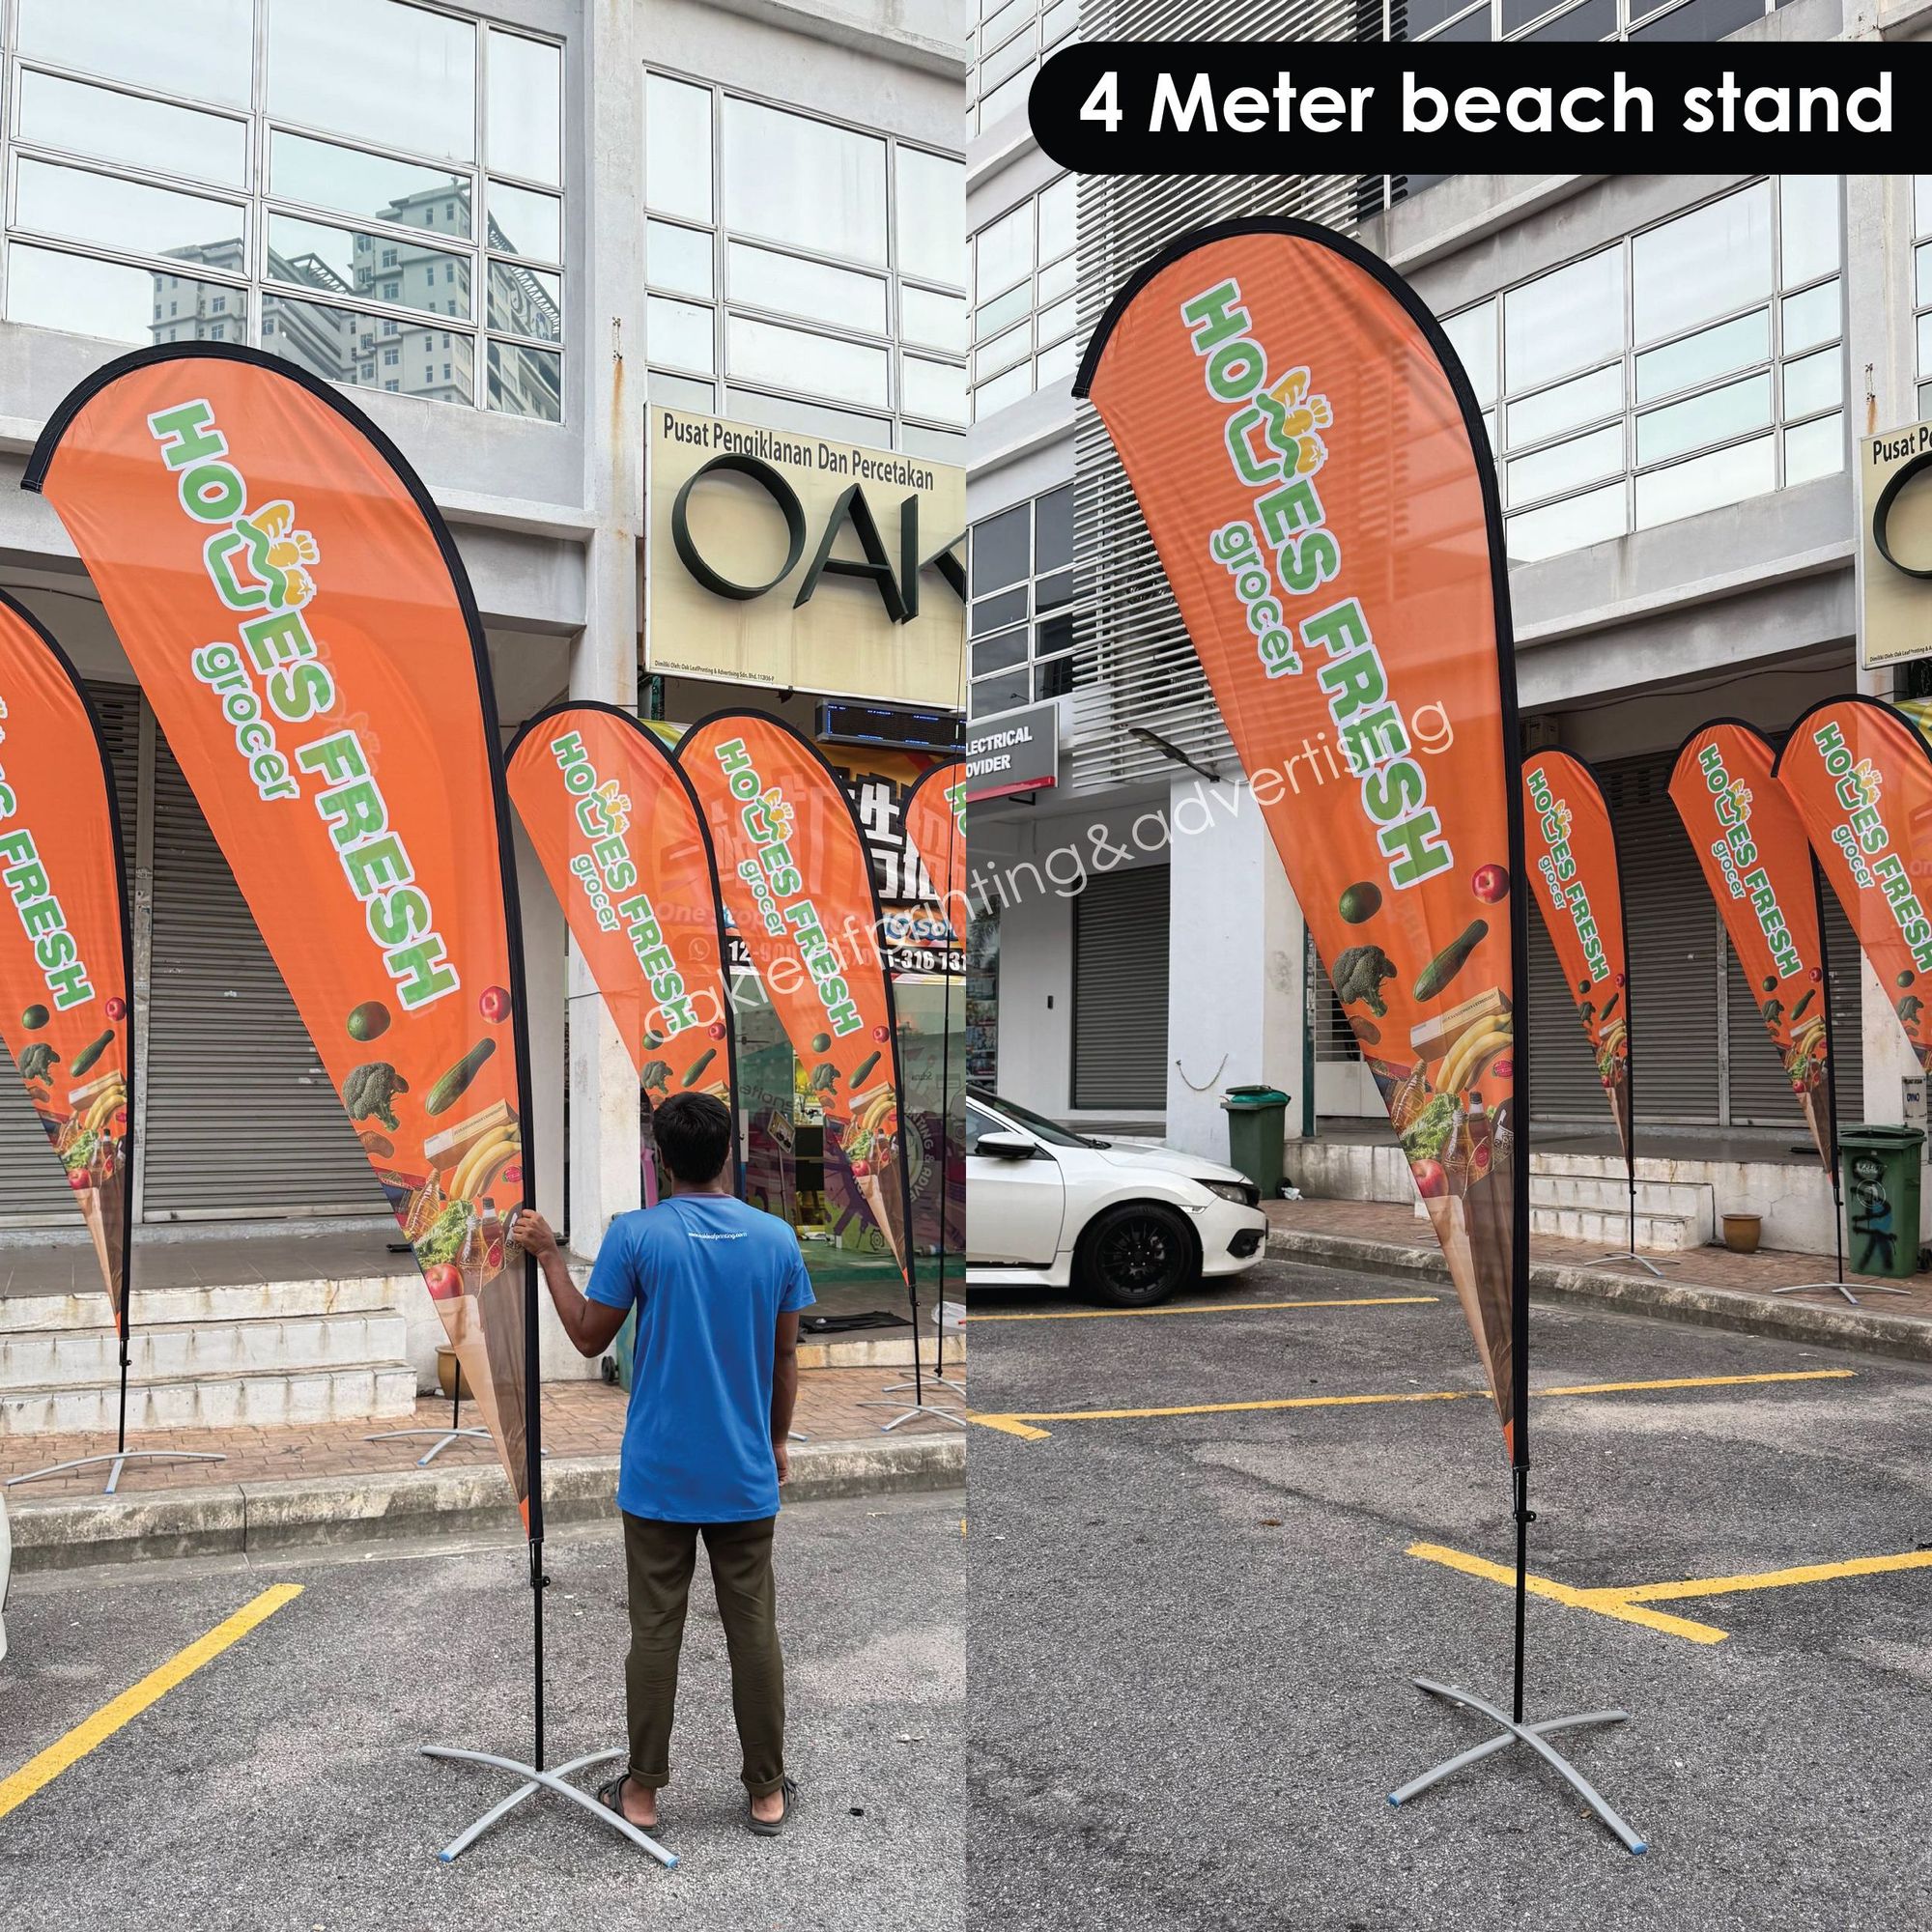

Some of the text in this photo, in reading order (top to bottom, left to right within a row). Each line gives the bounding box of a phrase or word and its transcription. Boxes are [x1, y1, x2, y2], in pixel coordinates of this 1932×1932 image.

[664, 412, 934, 491] Pusat Pengiklanan Dan Percetakan
[1873, 433, 1916, 466] Pusat
[1209, 521, 1302, 679] grocer
[191, 642, 300, 802] grocer
[1300, 598, 1454, 890] FRESH
[295, 729, 461, 1010] FRESH
[570, 855, 620, 932] grocer
[737, 859, 787, 937] grocer
[1538, 855, 1567, 910] grocer
[1711, 839, 1746, 899] grocer
[1833, 825, 1875, 889] grocer
[618, 895, 697, 1034] FRESH
[783, 899, 864, 1037] FRESH
[1565, 880, 1610, 982] FRESH
[1744, 867, 1804, 979] FRESH
